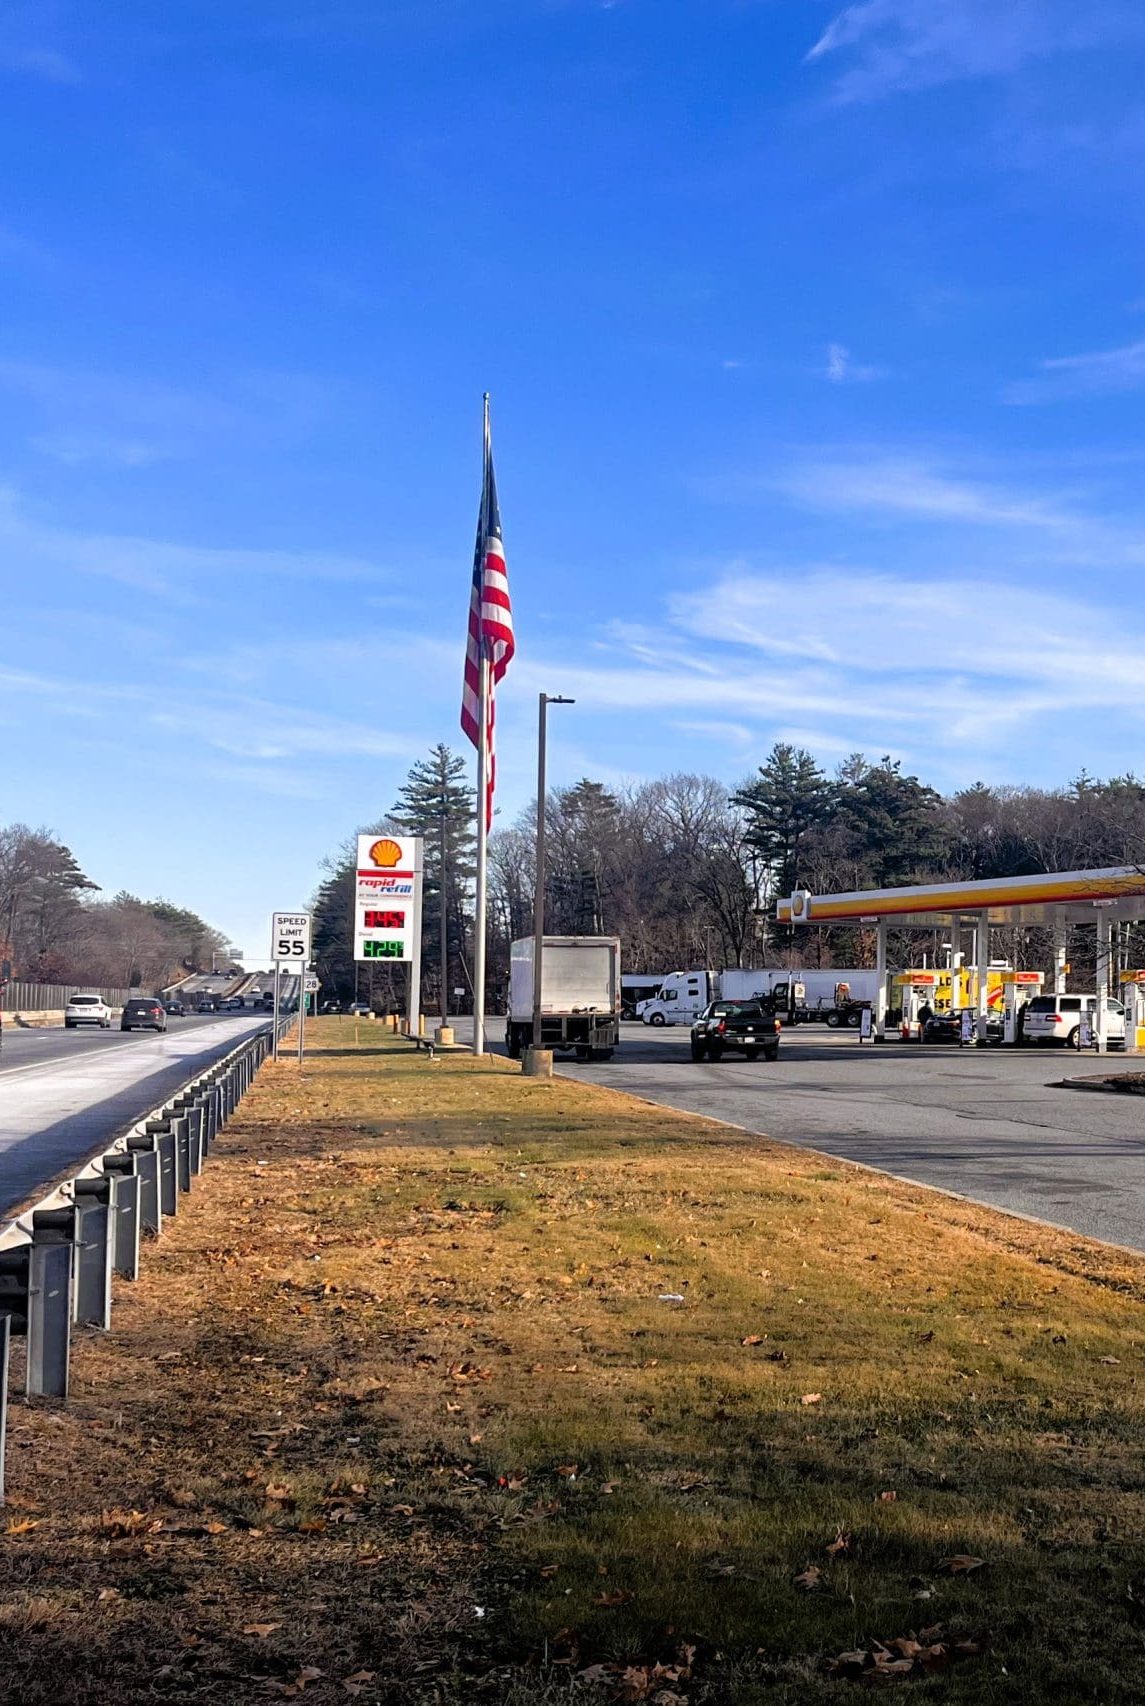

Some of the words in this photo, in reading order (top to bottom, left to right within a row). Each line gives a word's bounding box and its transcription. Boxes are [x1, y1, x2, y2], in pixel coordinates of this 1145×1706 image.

[358, 879, 396, 888] rapid
[380, 885, 412, 893] refill
[277, 917, 307, 925] SPEED
[278, 940, 305, 955] 55
[306, 980, 317, 988] 28
